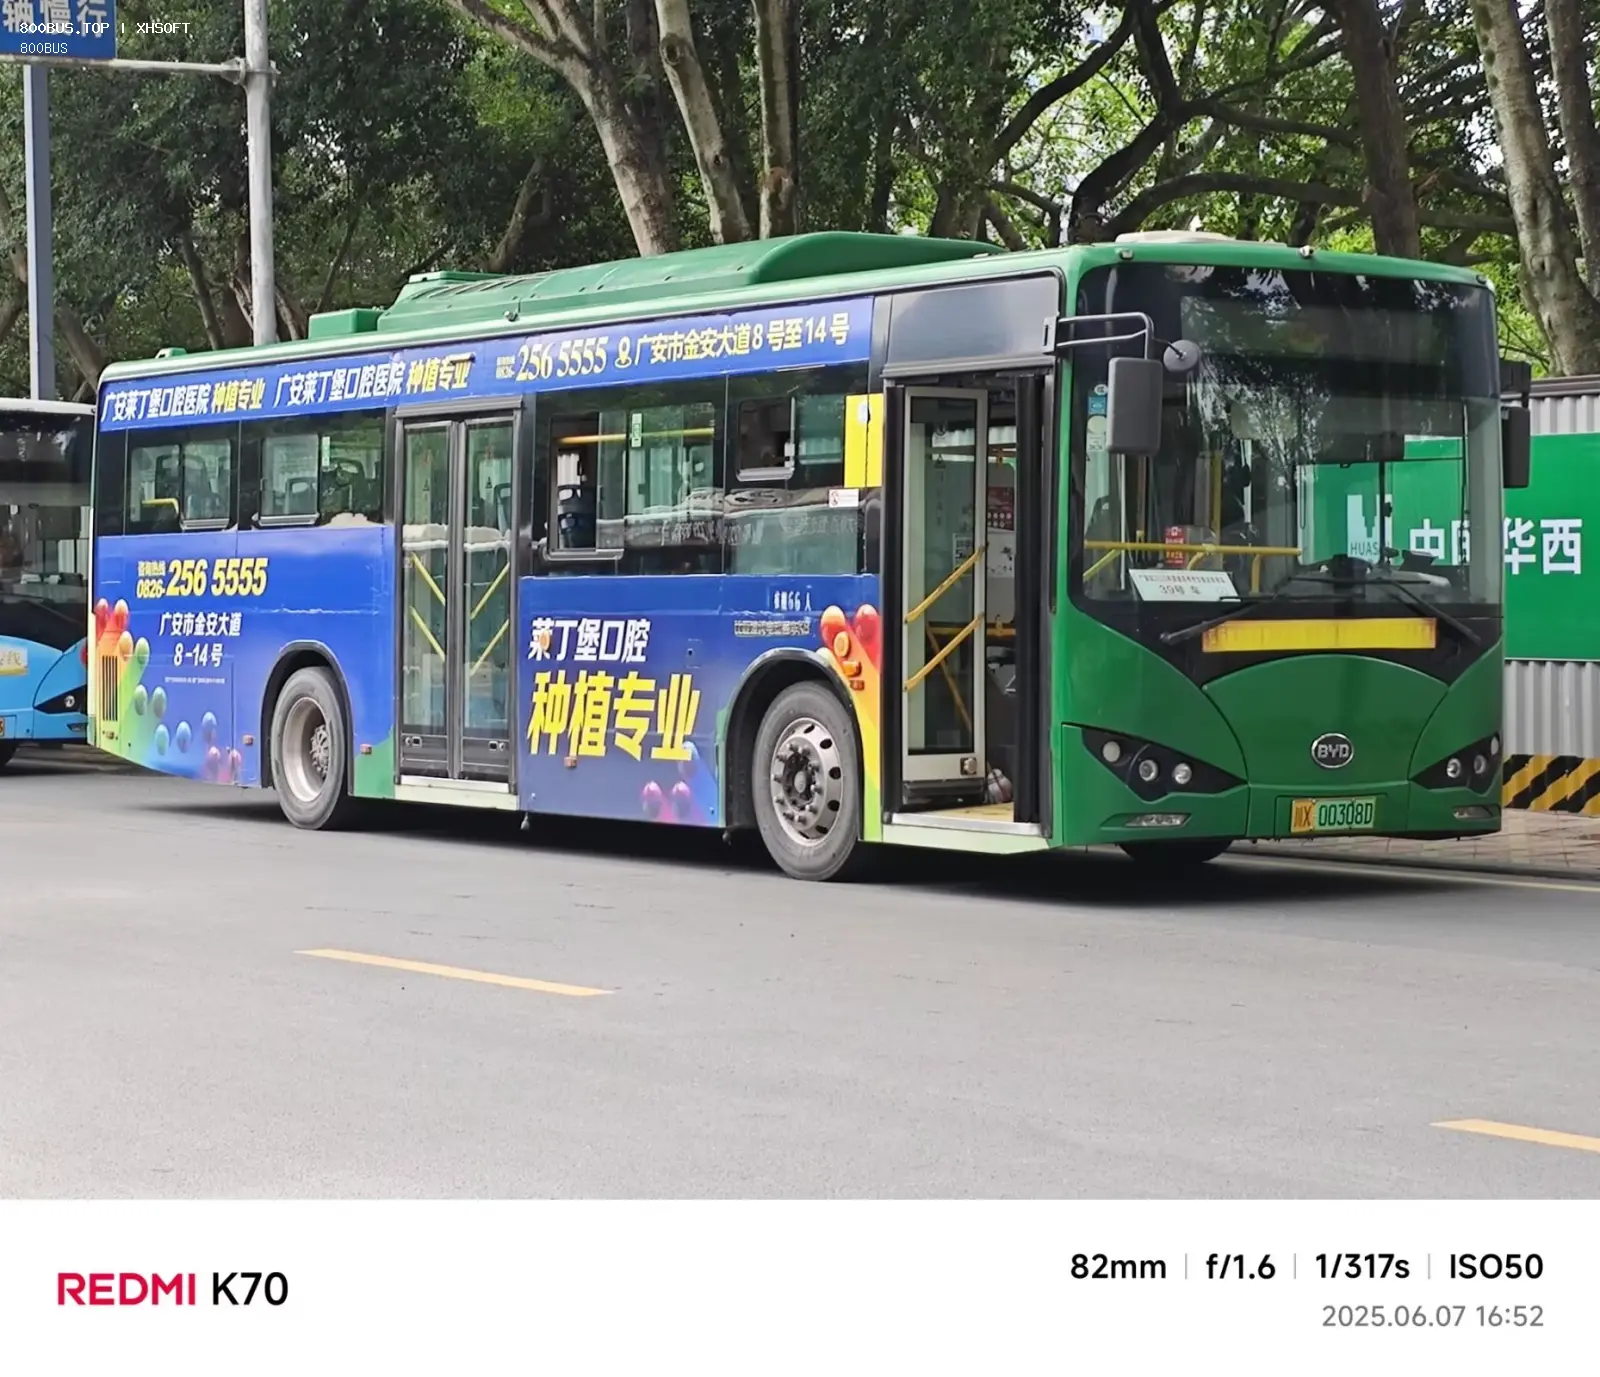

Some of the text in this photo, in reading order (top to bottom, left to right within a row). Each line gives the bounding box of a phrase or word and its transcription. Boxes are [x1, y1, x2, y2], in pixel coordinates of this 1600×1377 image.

[516, 343, 556, 381] 256
[557, 336, 609, 378] 5555
[100, 384, 212, 423] 广安莱丁堡口腔医院
[211, 377, 266, 414] 种植专业
[273, 361, 407, 408] 广安莱丁堡口腔医院
[165, 558, 209, 597] 256
[210, 557, 269, 597] 5555
[159, 612, 242, 637] 广安市金安大道
[527, 617, 651, 663] 莱丁堡口腔
[527, 669, 701, 761] 种植专业
[1317, 743, 1350, 759] BYD
